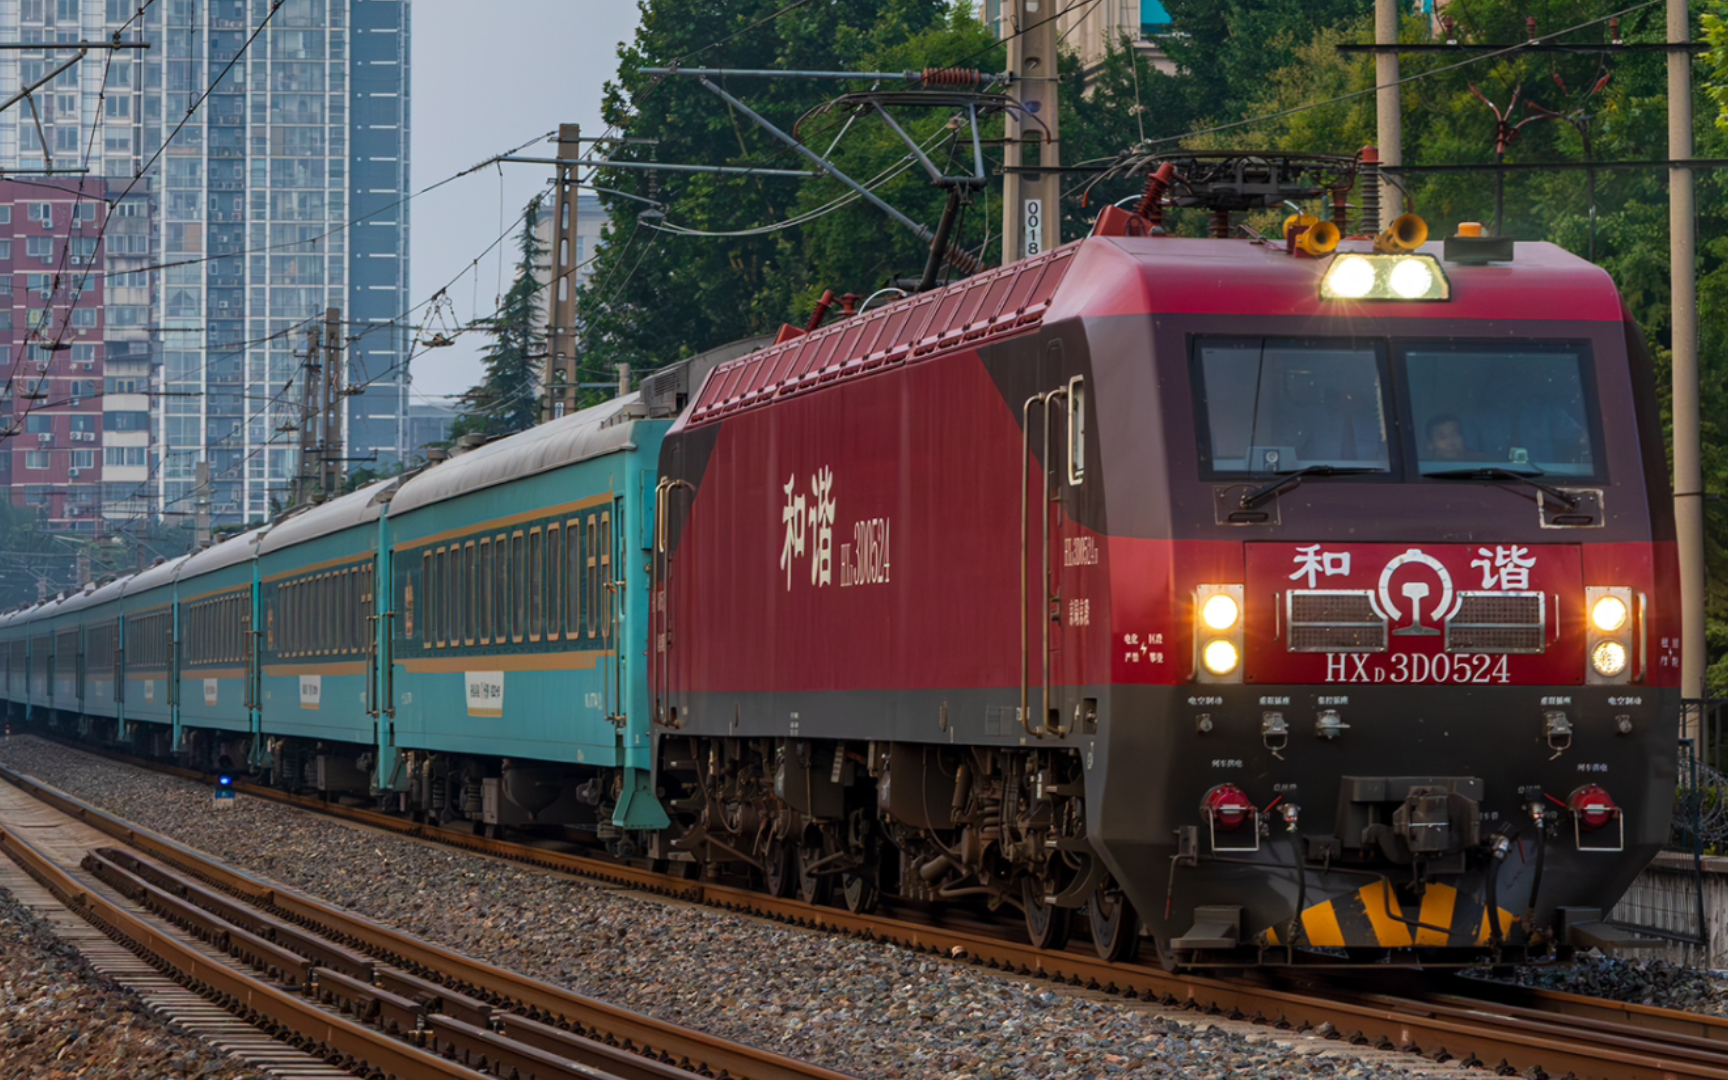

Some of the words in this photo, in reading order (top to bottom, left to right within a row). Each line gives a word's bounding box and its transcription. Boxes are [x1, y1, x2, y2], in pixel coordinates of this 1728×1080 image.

[1028, 202, 1039, 255] 0018
[780, 464, 836, 592] 和谐
[1288, 543, 1351, 589] 和
[1471, 544, 1537, 590] 谐
